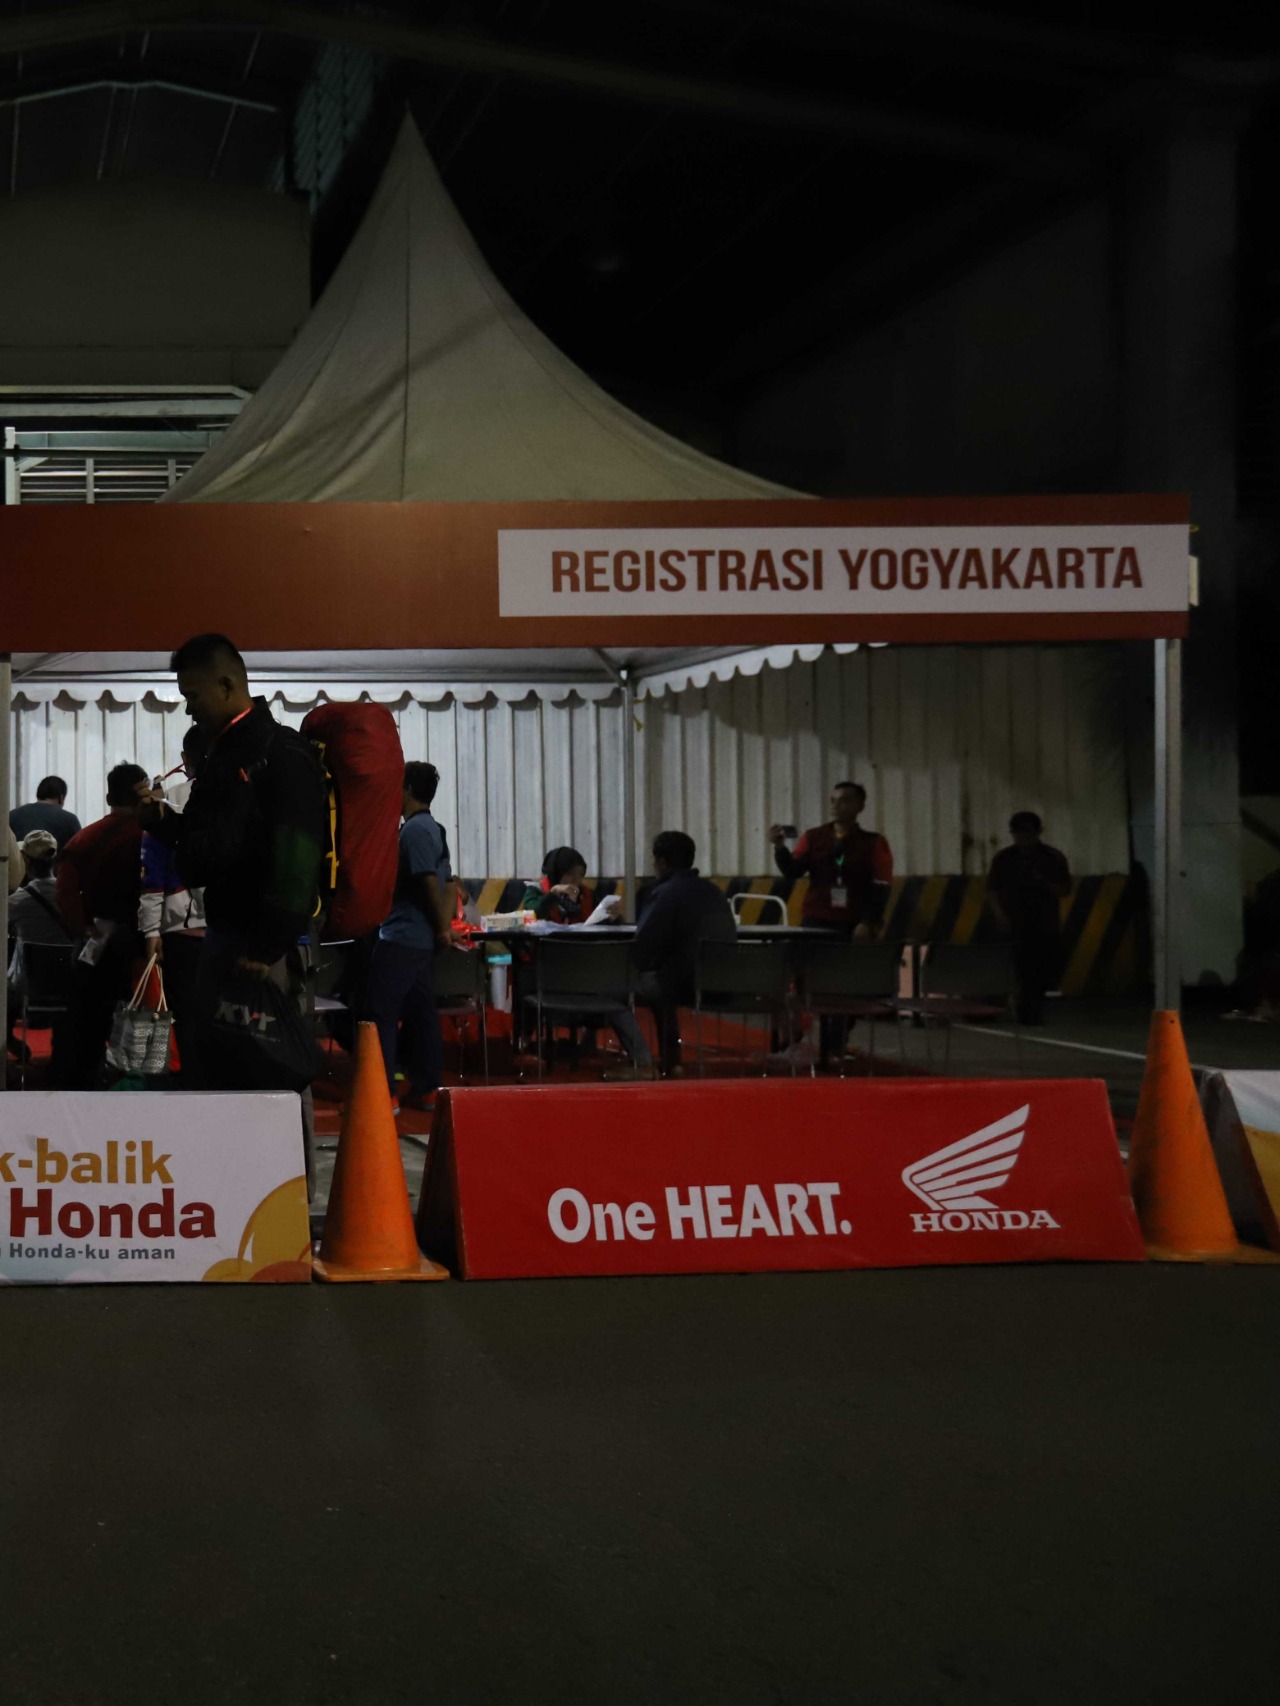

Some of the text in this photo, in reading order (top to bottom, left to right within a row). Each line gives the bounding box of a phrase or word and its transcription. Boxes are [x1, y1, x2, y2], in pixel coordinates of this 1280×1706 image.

[551, 546, 1143, 593] REGISTRASI YOGYAKARTA
[10, 1187, 216, 1239] Honda
[547, 1181, 853, 1243] One HEART.
[909, 1209, 1062, 1233] HONDA
[10, 1243, 110, 1259] Honda-ku
[118, 1247, 175, 1259] aman
